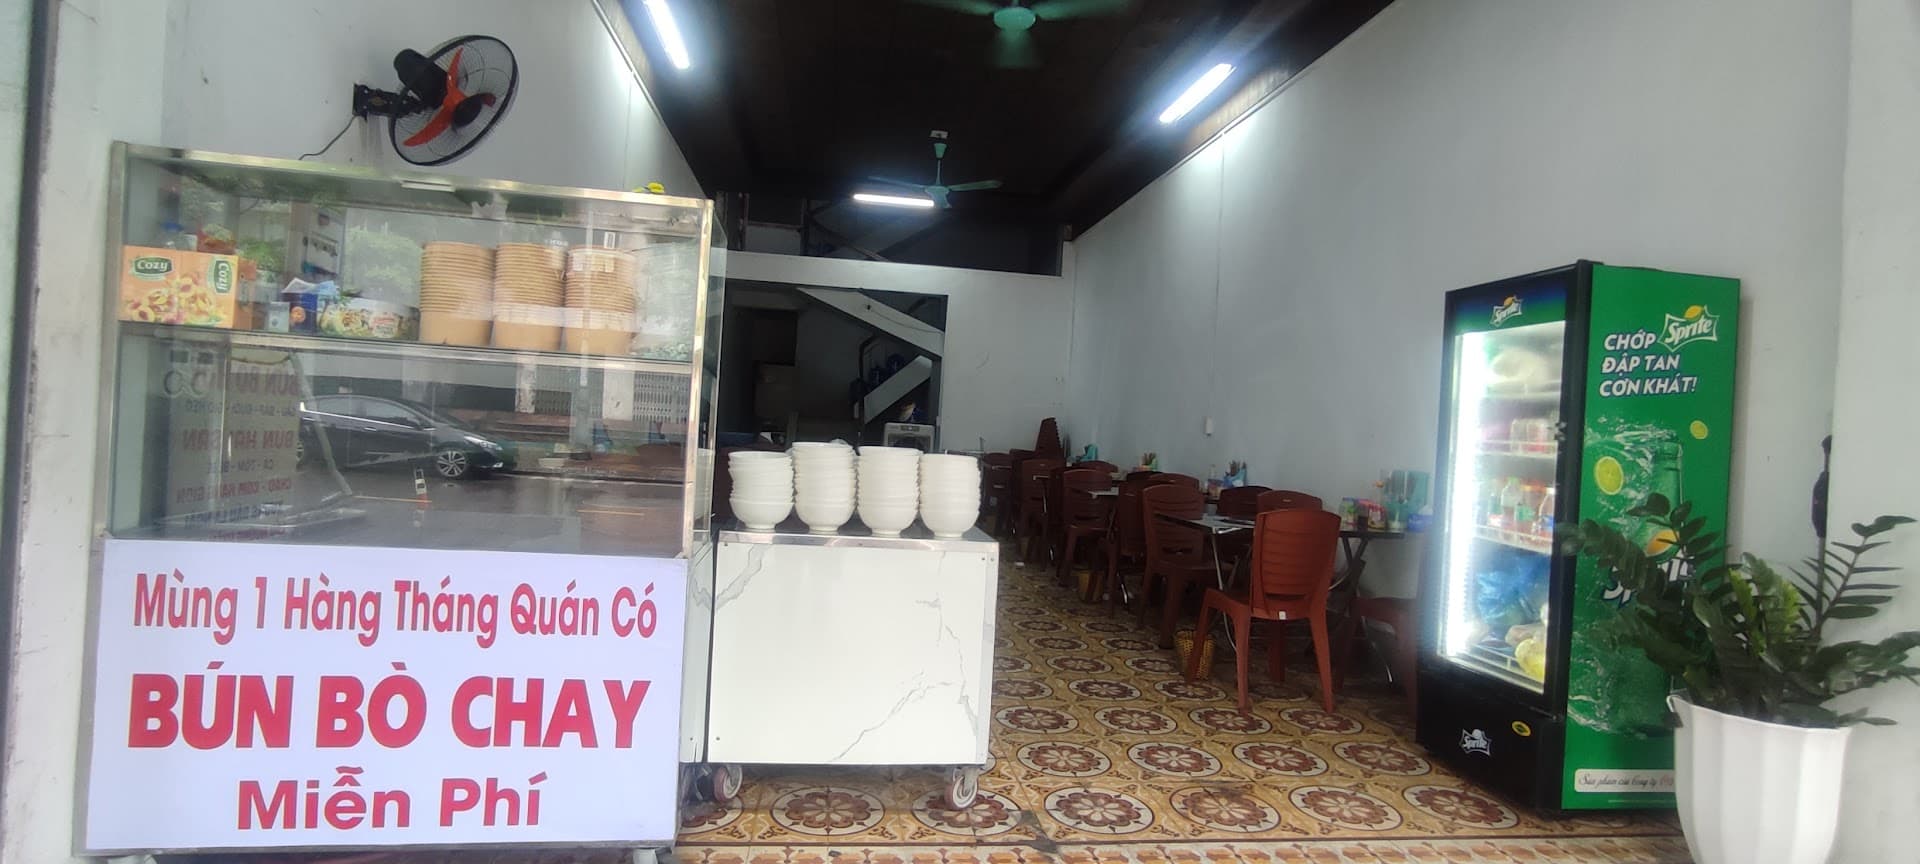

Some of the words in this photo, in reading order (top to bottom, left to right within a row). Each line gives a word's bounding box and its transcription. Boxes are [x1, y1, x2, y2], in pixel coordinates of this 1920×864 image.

[137, 260, 168, 272] Cozy
[218, 262, 230, 291] Cozy
[1603, 329, 1656, 350] CHỚP
[1664, 314, 1713, 345] Sprite
[1601, 352, 1640, 376] ĐẬP
[1644, 354, 1680, 371] TAN
[1599, 378, 1640, 397] CƠN
[1643, 373, 1698, 394] KHÁT!
[133, 567, 239, 645] Mùng
[254, 576, 268, 629] 1
[284, 572, 382, 647] Hàng
[394, 575, 498, 649] Tháng
[510, 579, 600, 637] Quán
[611, 581, 657, 639] Có
[127, 661, 294, 750] BÚN
[316, 662, 427, 749] BÒ
[451, 676, 652, 749] CHAY
[237, 765, 410, 831] Miễn
[439, 770, 548, 827] Phí
